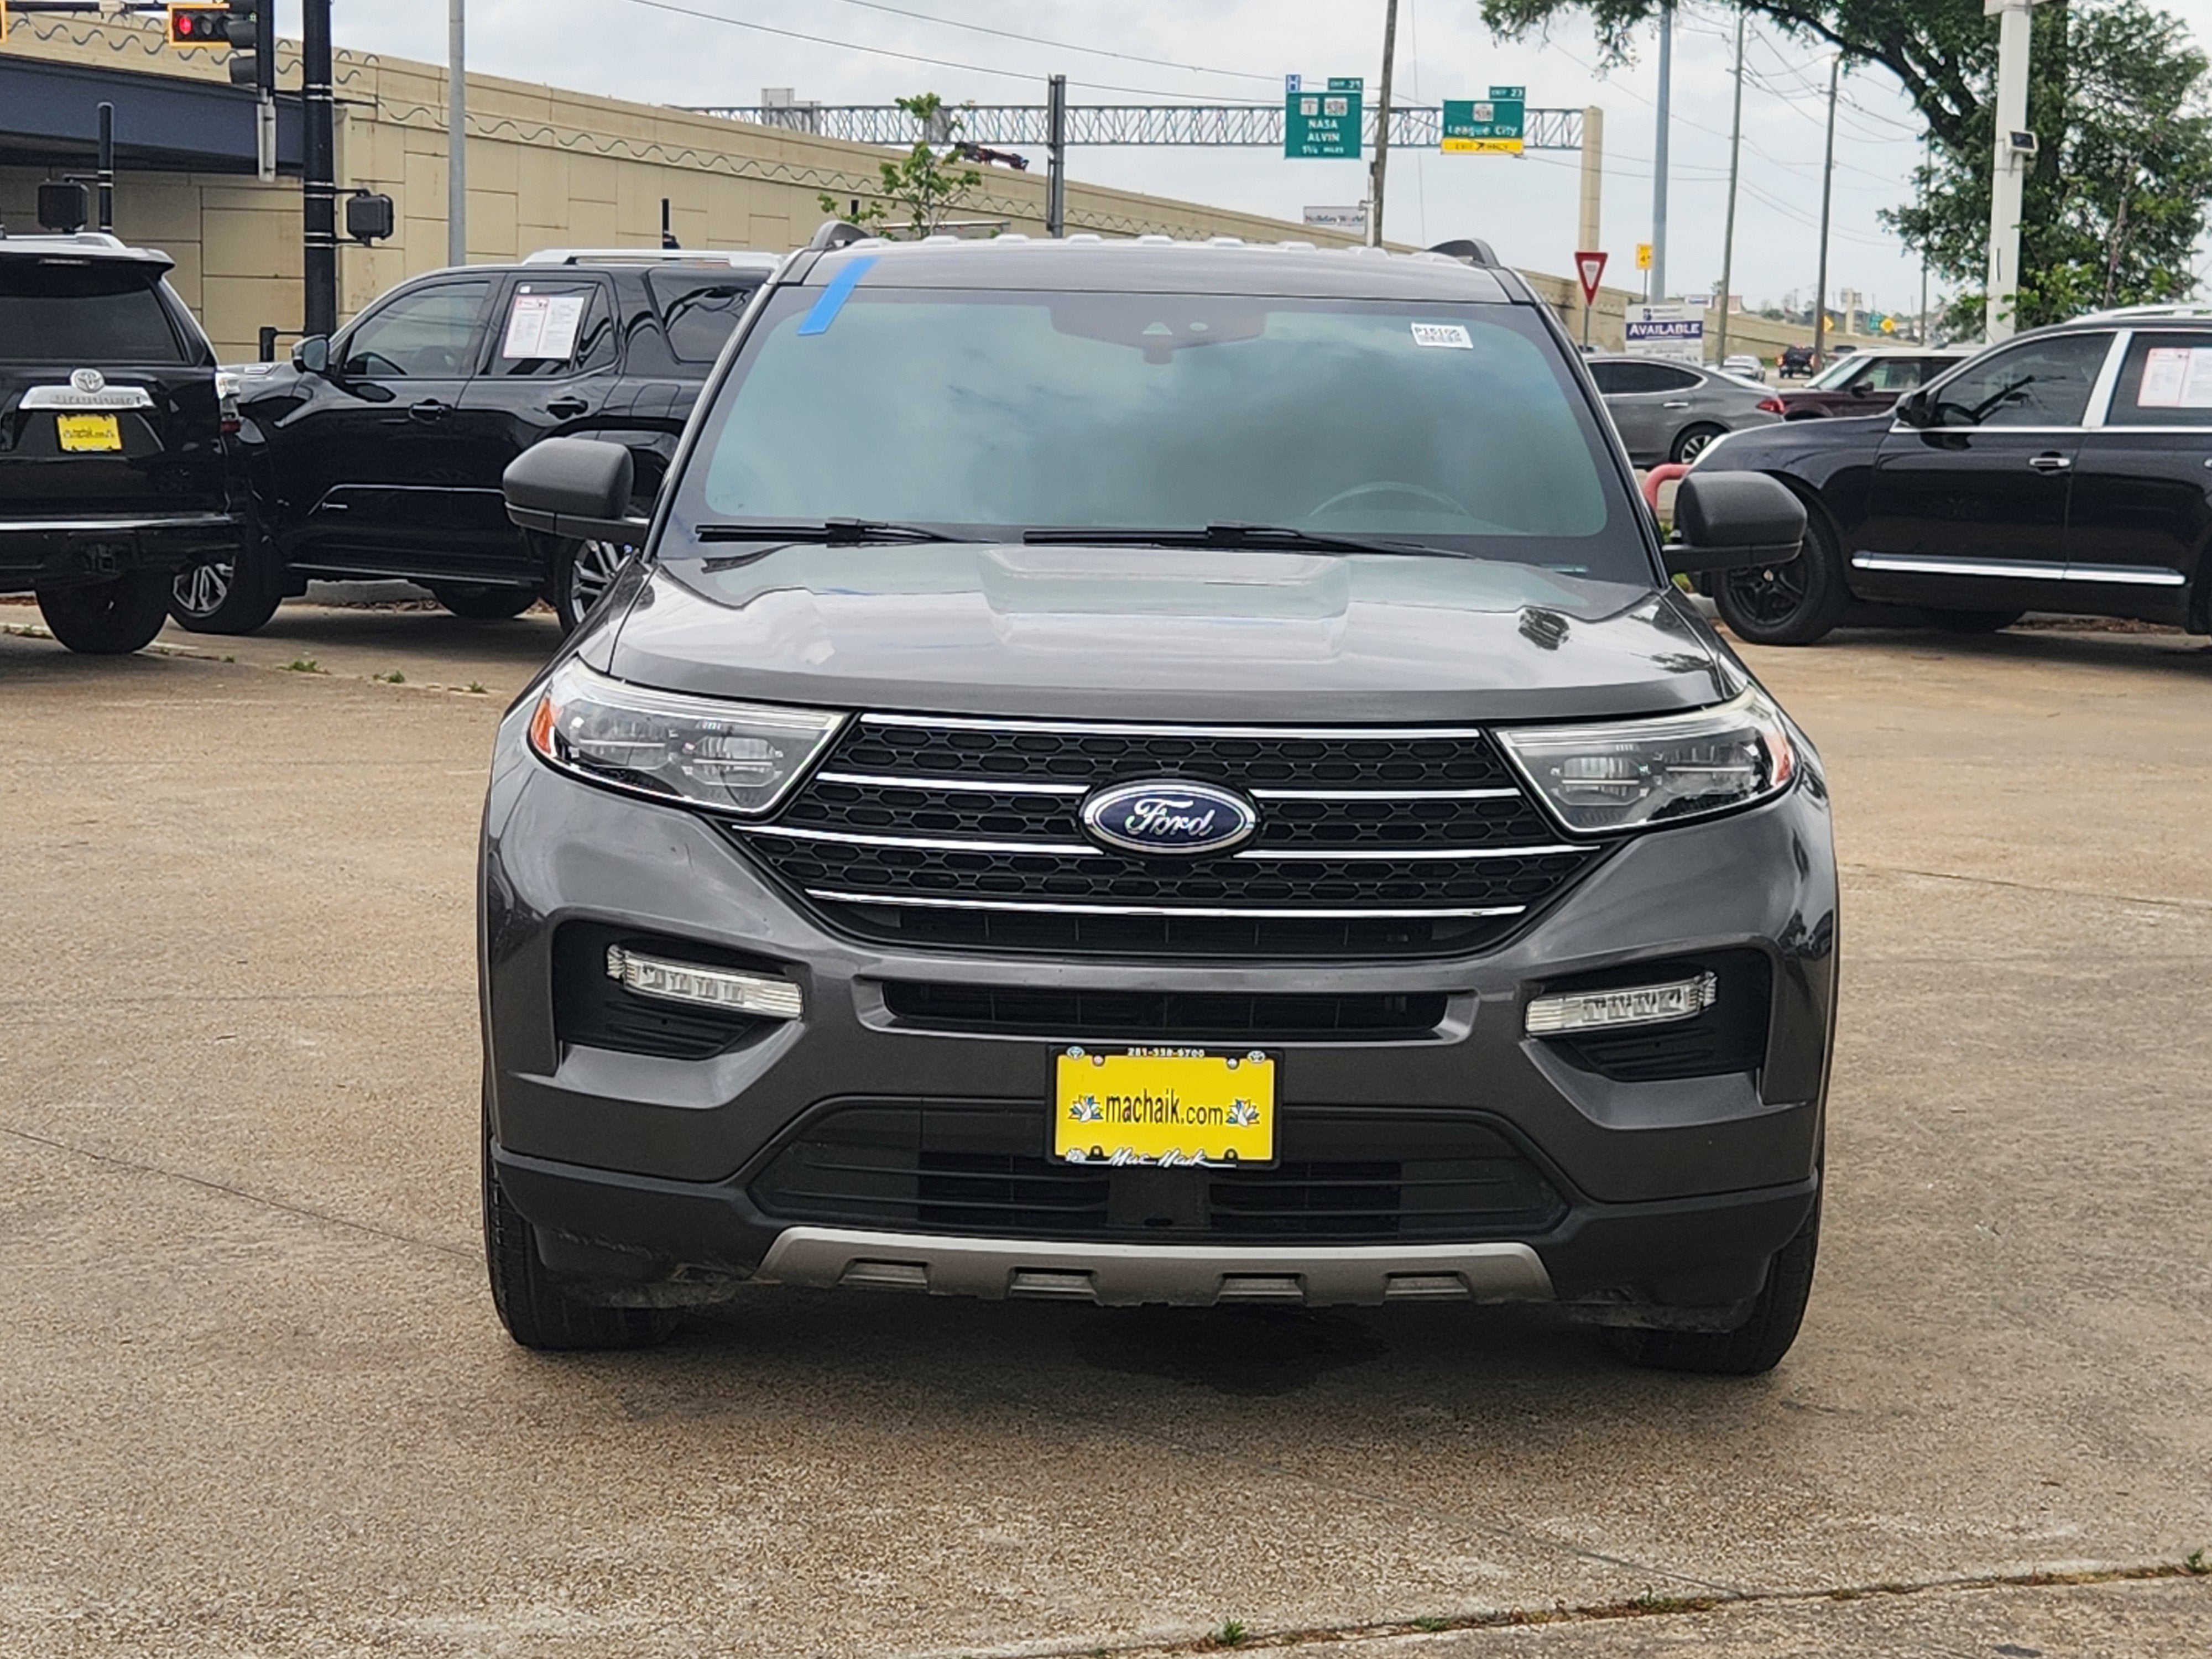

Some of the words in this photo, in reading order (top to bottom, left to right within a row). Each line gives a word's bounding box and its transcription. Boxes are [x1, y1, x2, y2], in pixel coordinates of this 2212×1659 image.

[1510, 88, 1523, 97] 23
[1307, 118, 1339, 129] NASA
[1447, 124, 1490, 137] League
[1494, 125, 1518, 137] City
[1307, 132, 1341, 143] ALVIN
[1628, 323, 1700, 336] AVAILABLE
[1125, 798, 1215, 836] Ford
[1106, 1088, 1223, 1125] machaik.com
[1107, 1146, 1156, 1167] Mac
[1157, 1148, 1209, 1168] Haik
